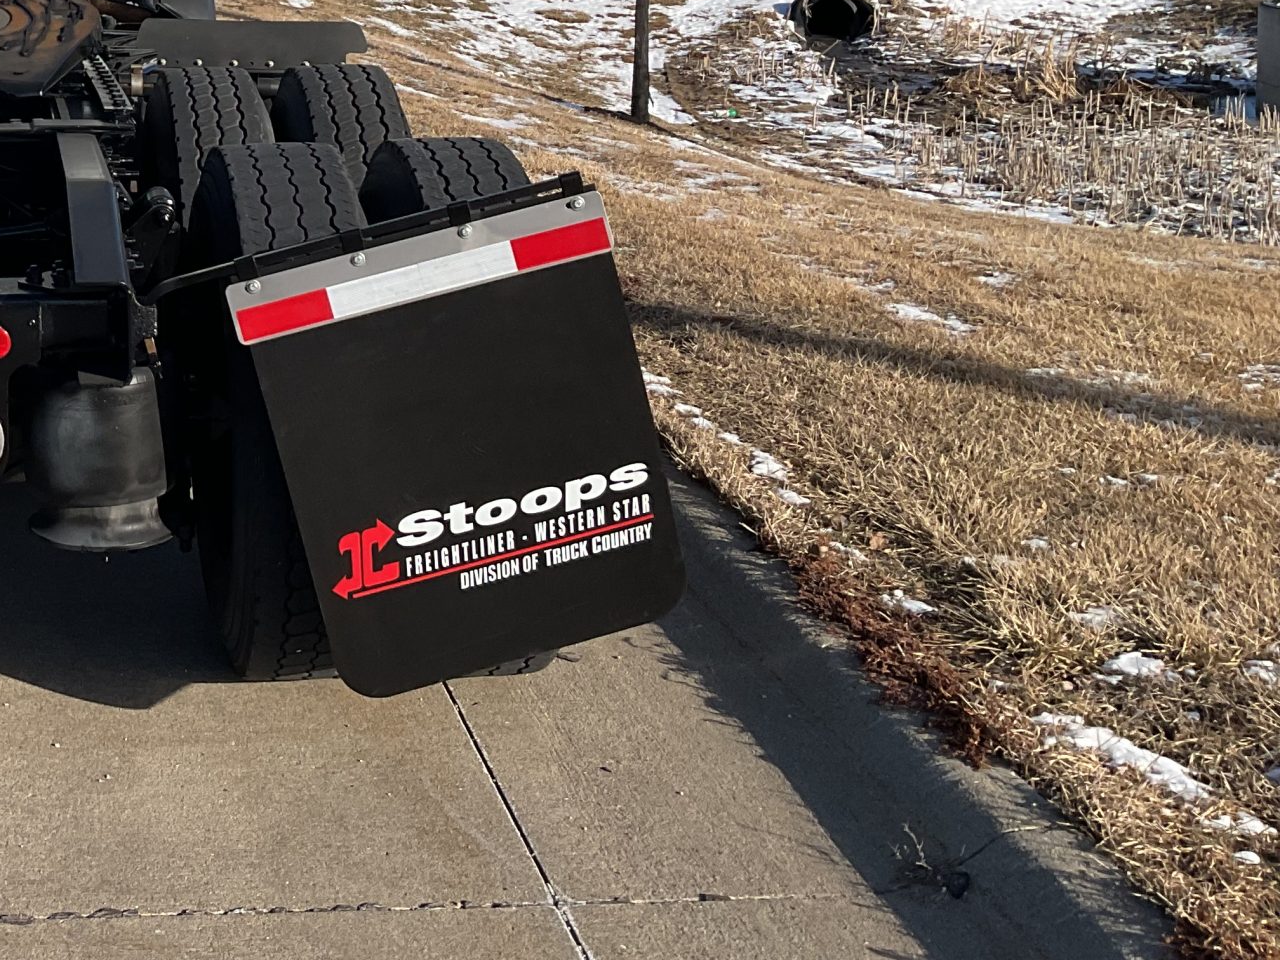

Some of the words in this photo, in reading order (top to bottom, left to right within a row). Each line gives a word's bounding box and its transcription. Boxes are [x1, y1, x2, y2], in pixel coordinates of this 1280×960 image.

[396, 462, 648, 547] Stoops
[406, 530, 516, 577] FREIGHTLINER
[534, 505, 605, 542] WESTERN
[613, 494, 650, 521] STAR
[460, 558, 520, 590] DIVISION
[523, 553, 540, 573] OF
[544, 538, 589, 567] TRUCK
[591, 523, 653, 555] COUNTRY
